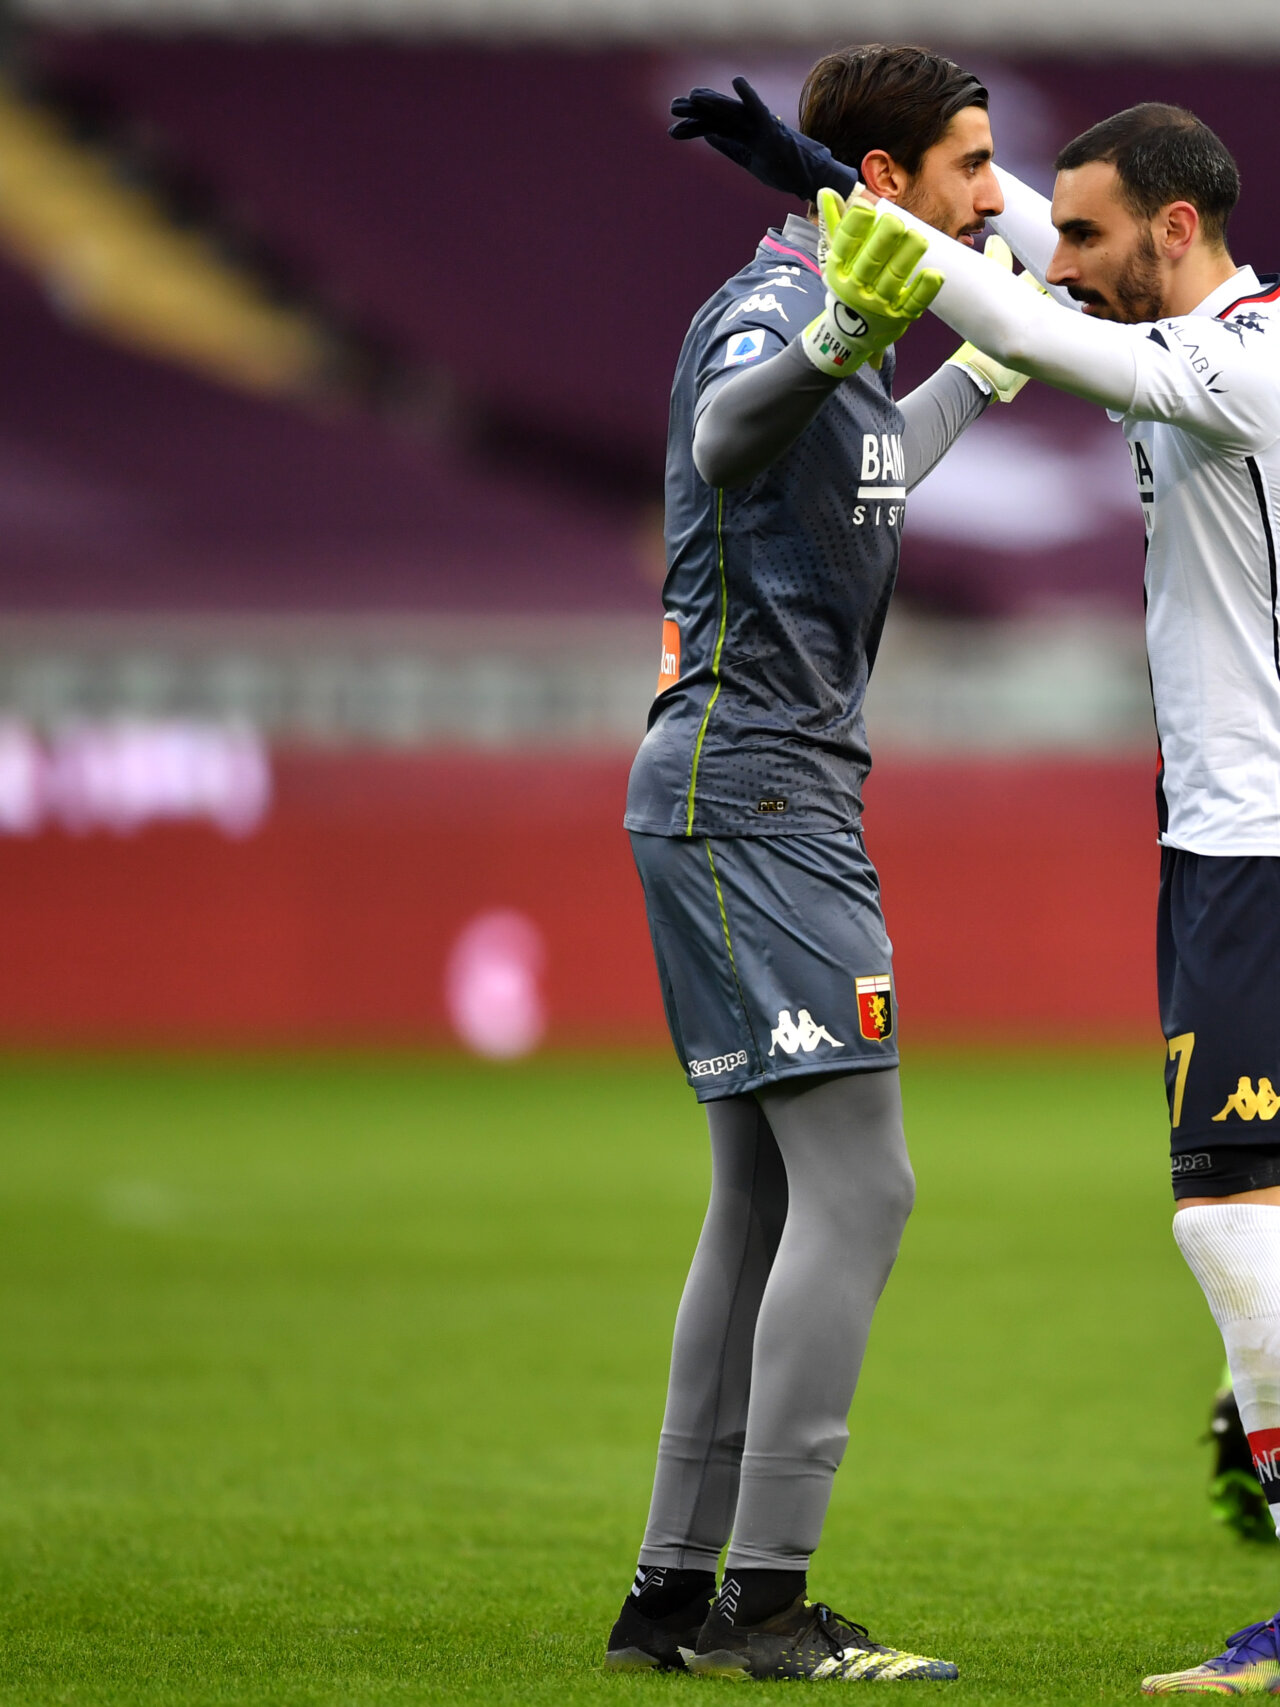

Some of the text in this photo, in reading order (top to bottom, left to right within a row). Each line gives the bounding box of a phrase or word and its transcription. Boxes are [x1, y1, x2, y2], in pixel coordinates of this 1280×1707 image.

[823, 331, 853, 362] PERIN
[860, 433, 906, 481] BAN
[852, 505, 905, 527] SIST
[688, 1050, 748, 1078] Kappa
[1167, 1031, 1196, 1129] 7
[1171, 1153, 1212, 1173] ppa
